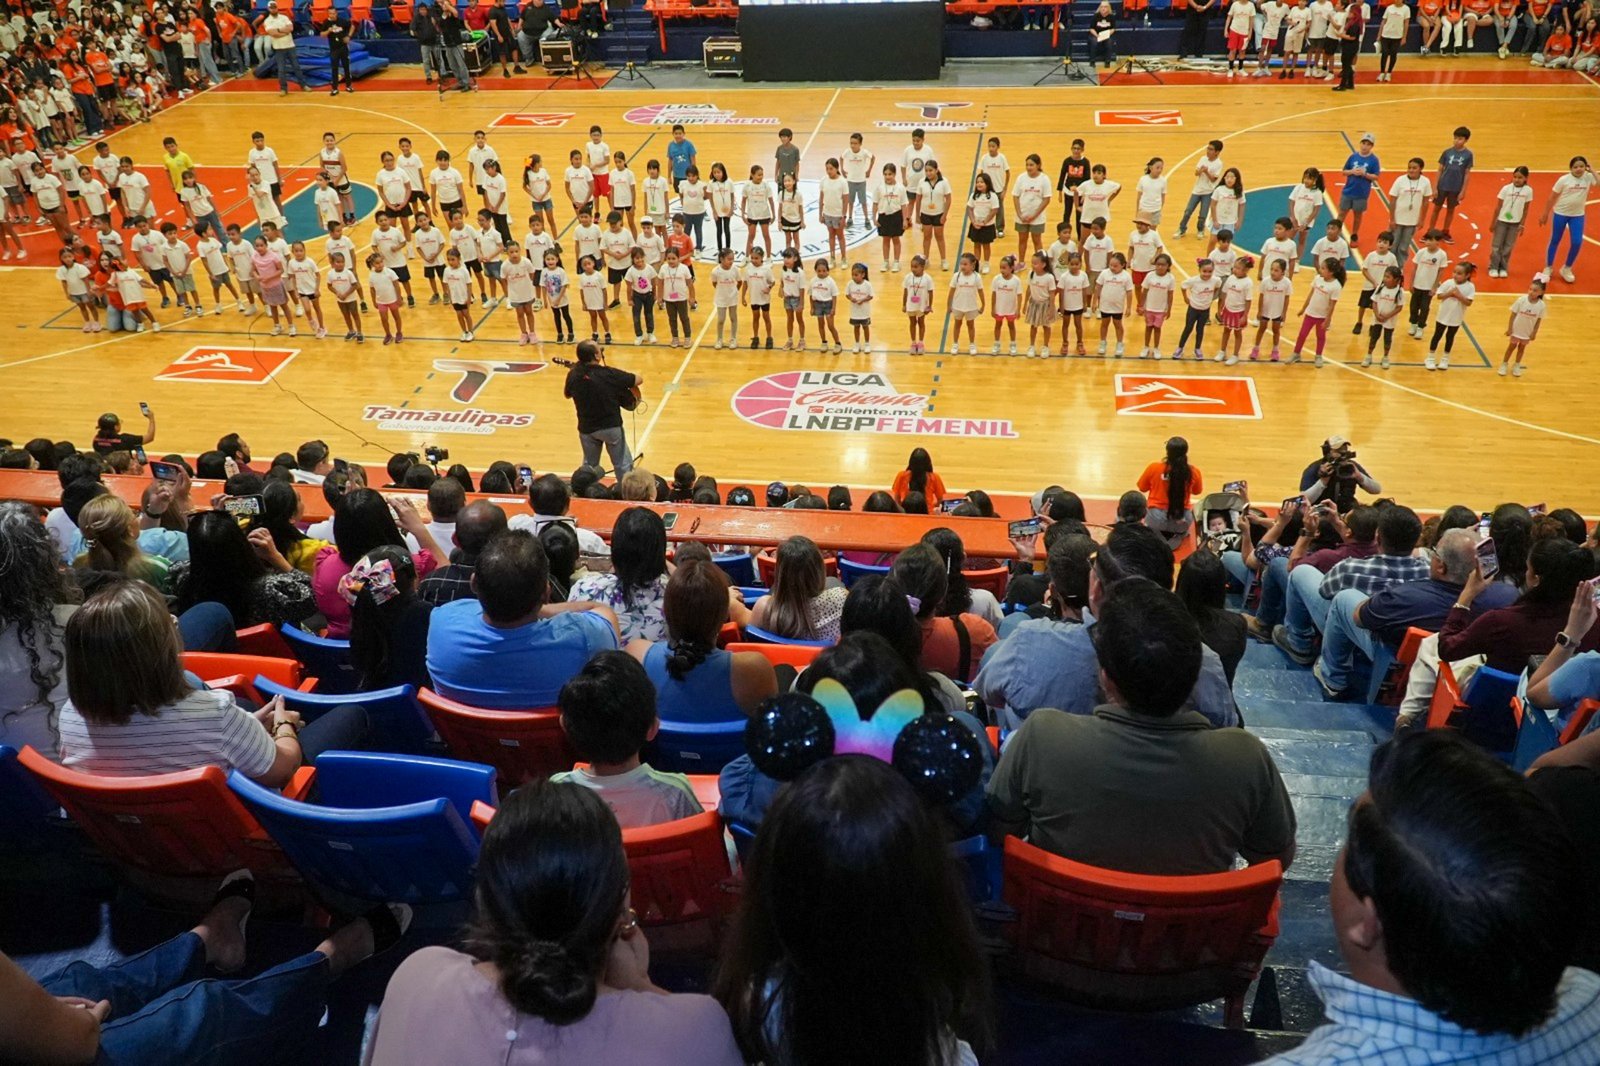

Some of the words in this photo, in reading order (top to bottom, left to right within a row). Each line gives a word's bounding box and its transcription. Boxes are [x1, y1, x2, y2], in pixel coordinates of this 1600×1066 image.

[802, 372, 885, 387] LIGA
[795, 387, 926, 406] Caliente
[365, 406, 532, 427] Tamaulipas
[825, 406, 918, 417] caliente.mx
